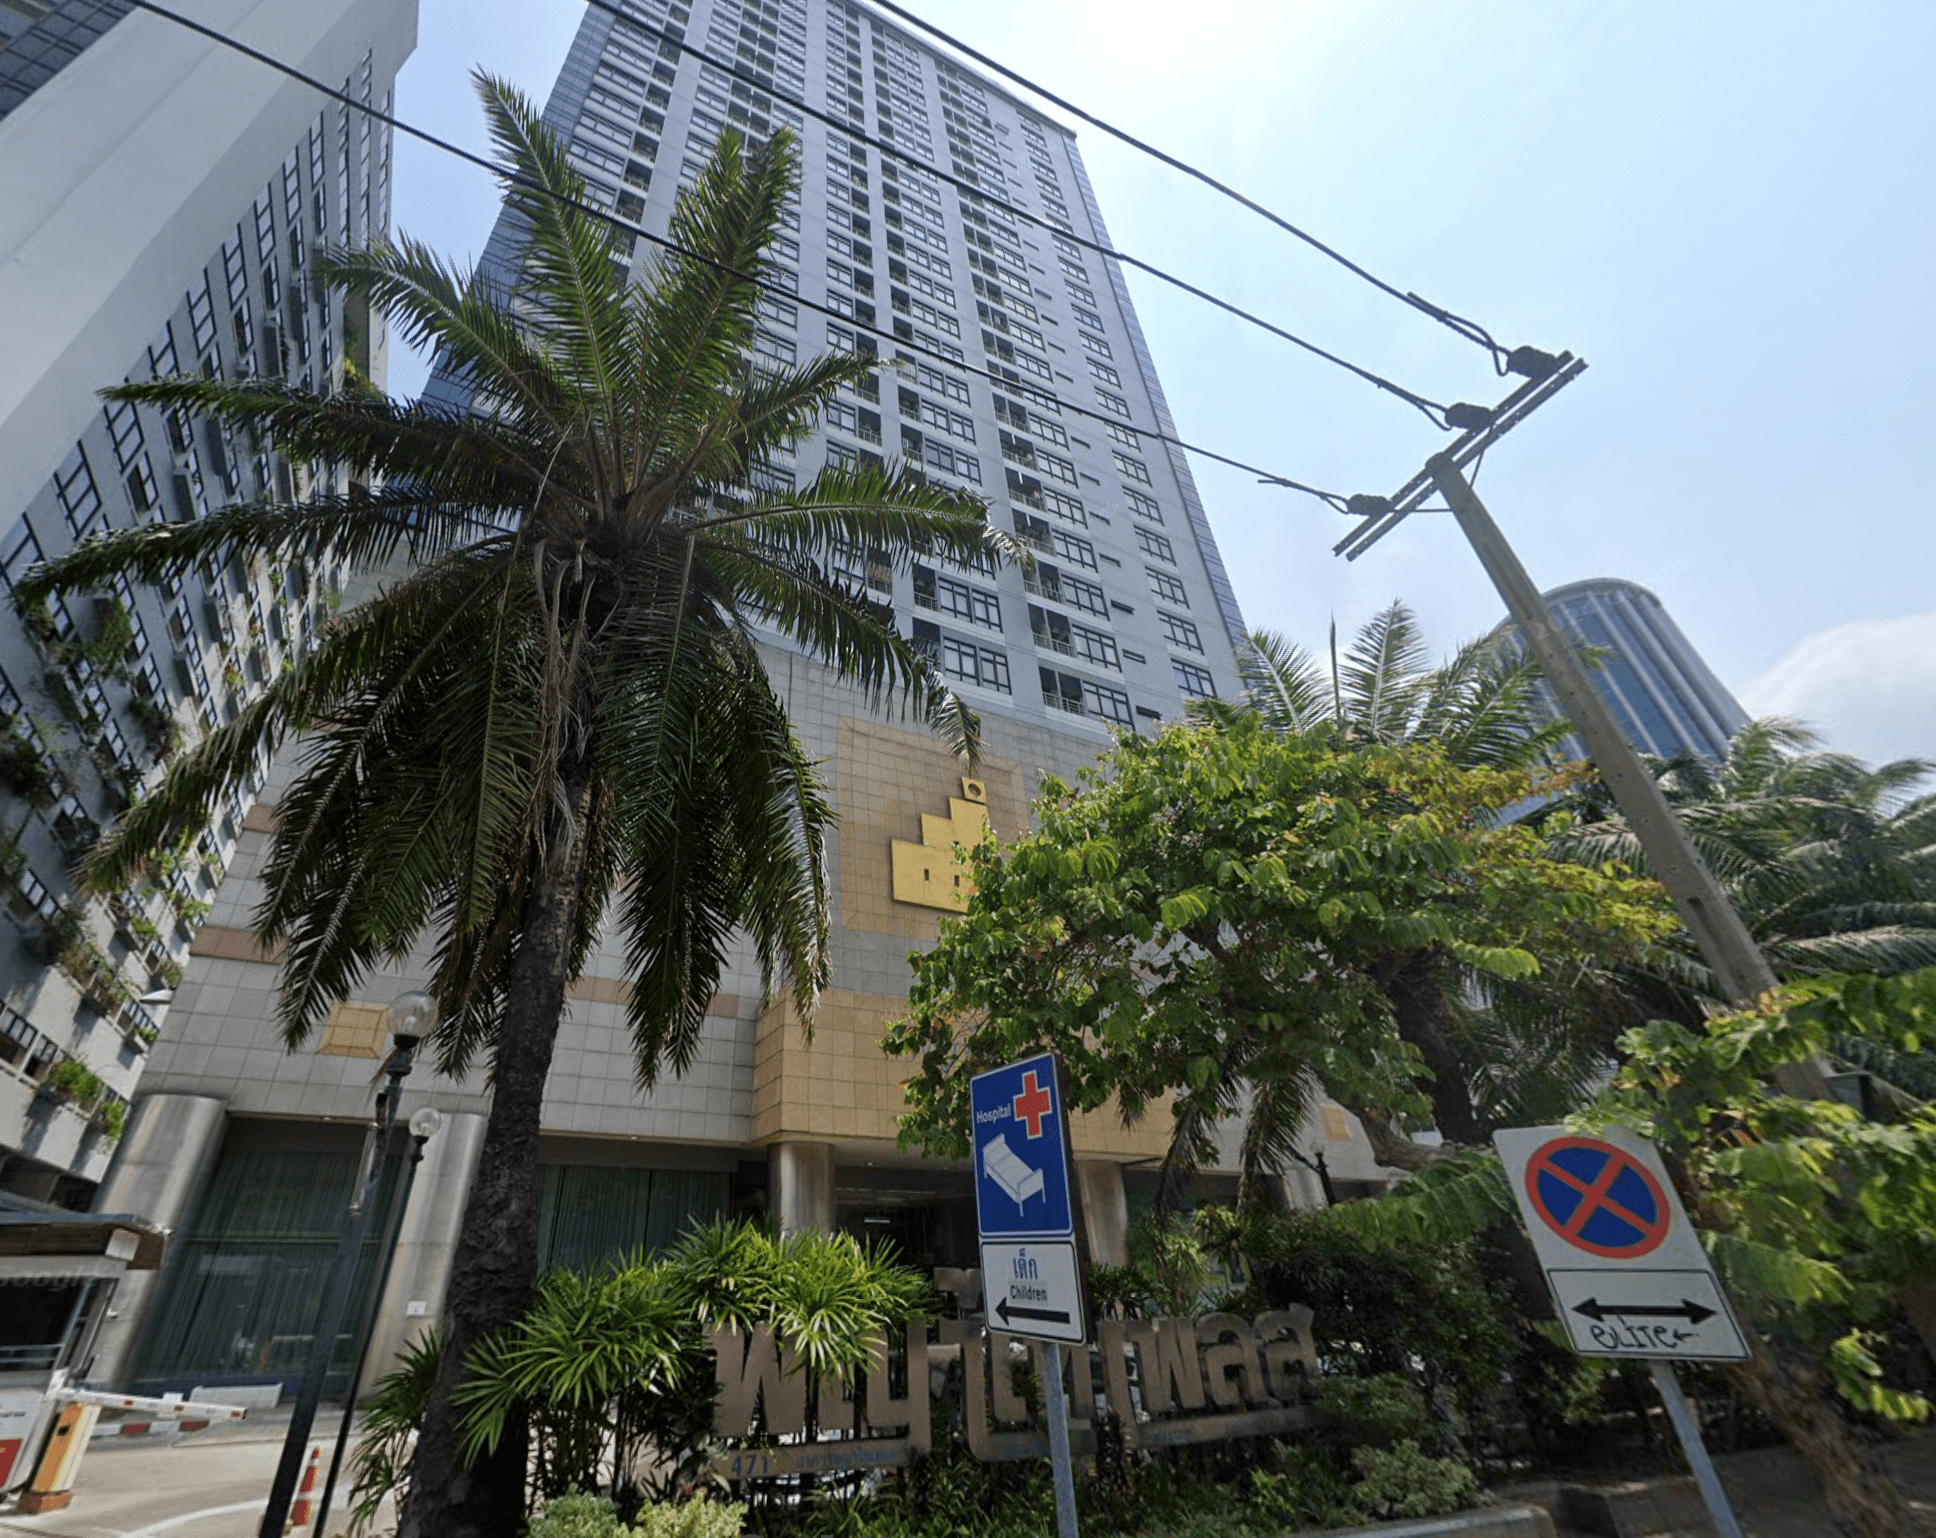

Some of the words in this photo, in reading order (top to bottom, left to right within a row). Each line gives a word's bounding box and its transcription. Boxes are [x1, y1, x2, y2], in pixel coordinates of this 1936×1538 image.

[976, 1102, 1011, 1125] Hospital
[1010, 1284, 1047, 1301] Children
[732, 1454, 769, 1477] 471
